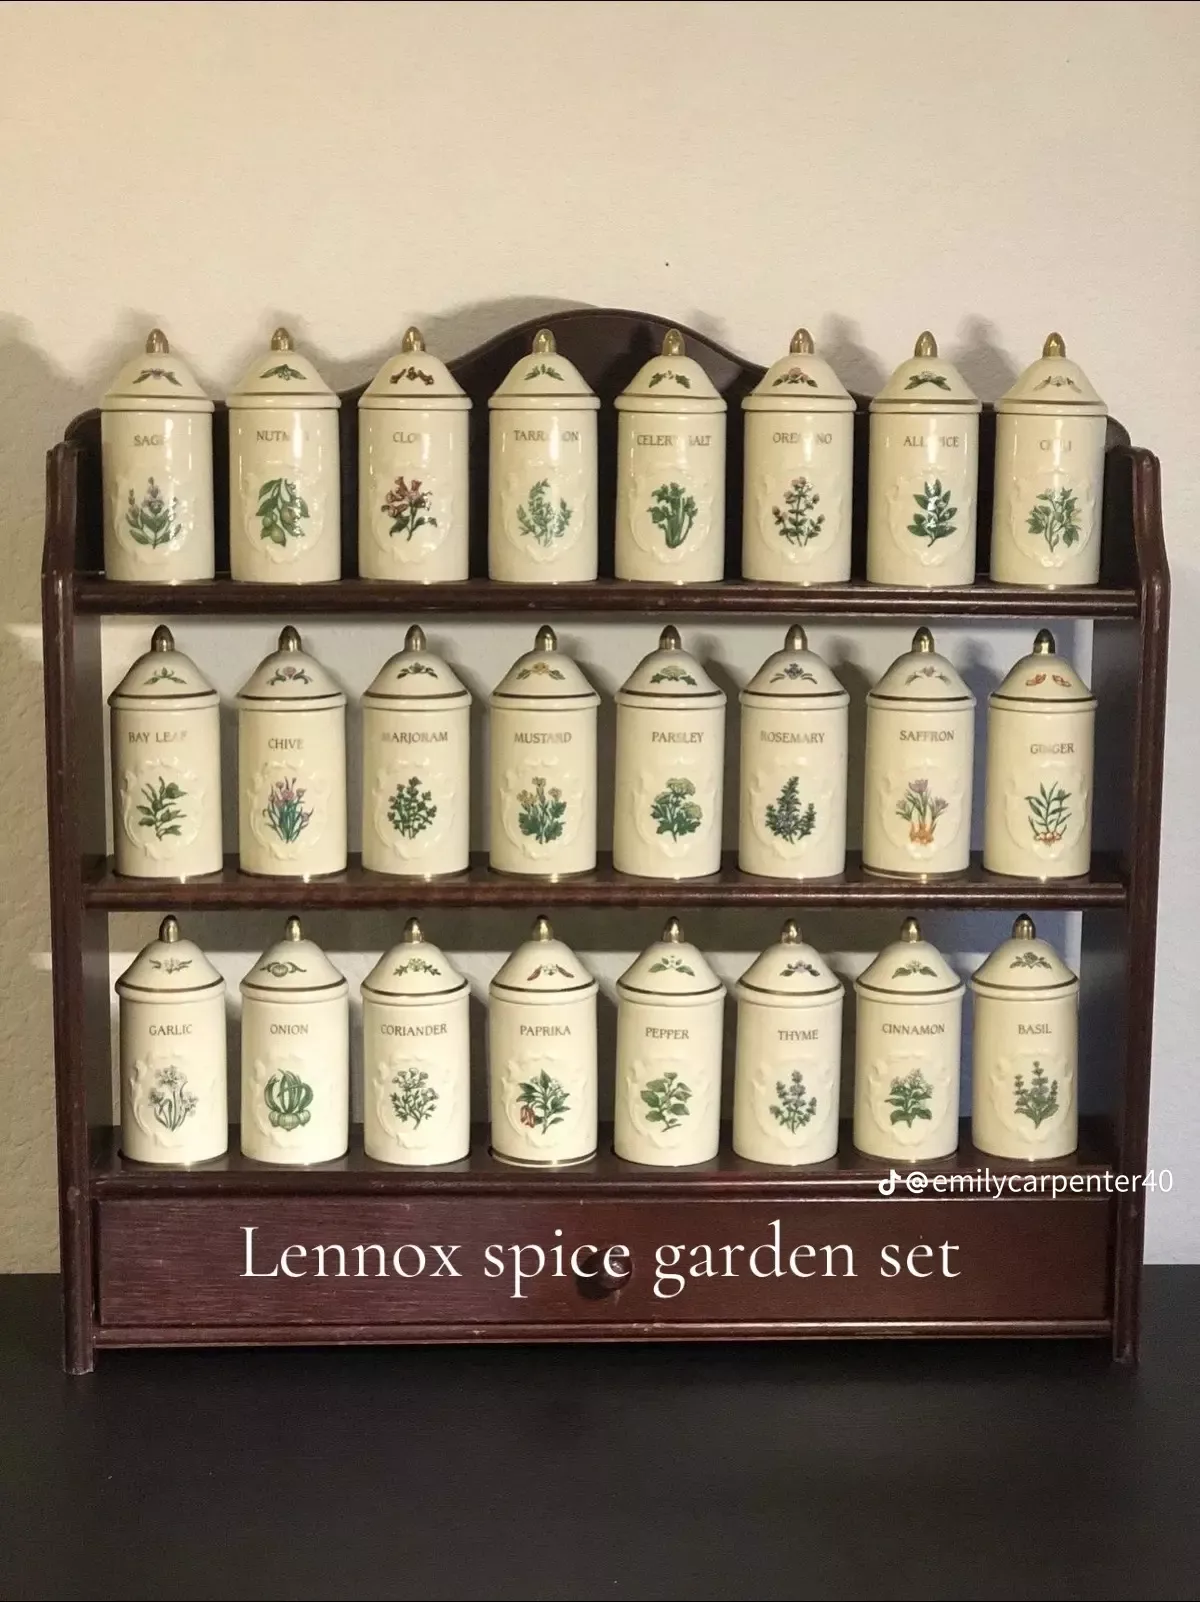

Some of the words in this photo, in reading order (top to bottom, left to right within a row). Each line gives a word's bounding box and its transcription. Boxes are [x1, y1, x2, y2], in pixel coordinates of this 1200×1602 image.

[513, 430, 580, 442] TARRON
[772, 432, 833, 445] ORENO
[903, 435, 960, 447] ALLICE
[128, 731, 151, 744] BAY
[760, 730, 825, 744] ROSEMARY
[899, 730, 955, 743] SAFFRON
[148, 1024, 193, 1036] GARLIC
[269, 1024, 309, 1035] ONION
[380, 1023, 448, 1037] CORIANDER
[519, 1024, 571, 1037] PAPRIKA
[645, 1026, 690, 1040] PEPPER
[777, 1029, 819, 1042] THYME
[882, 1023, 945, 1036] CINNAMON
[1018, 1023, 1052, 1036] BASIL
